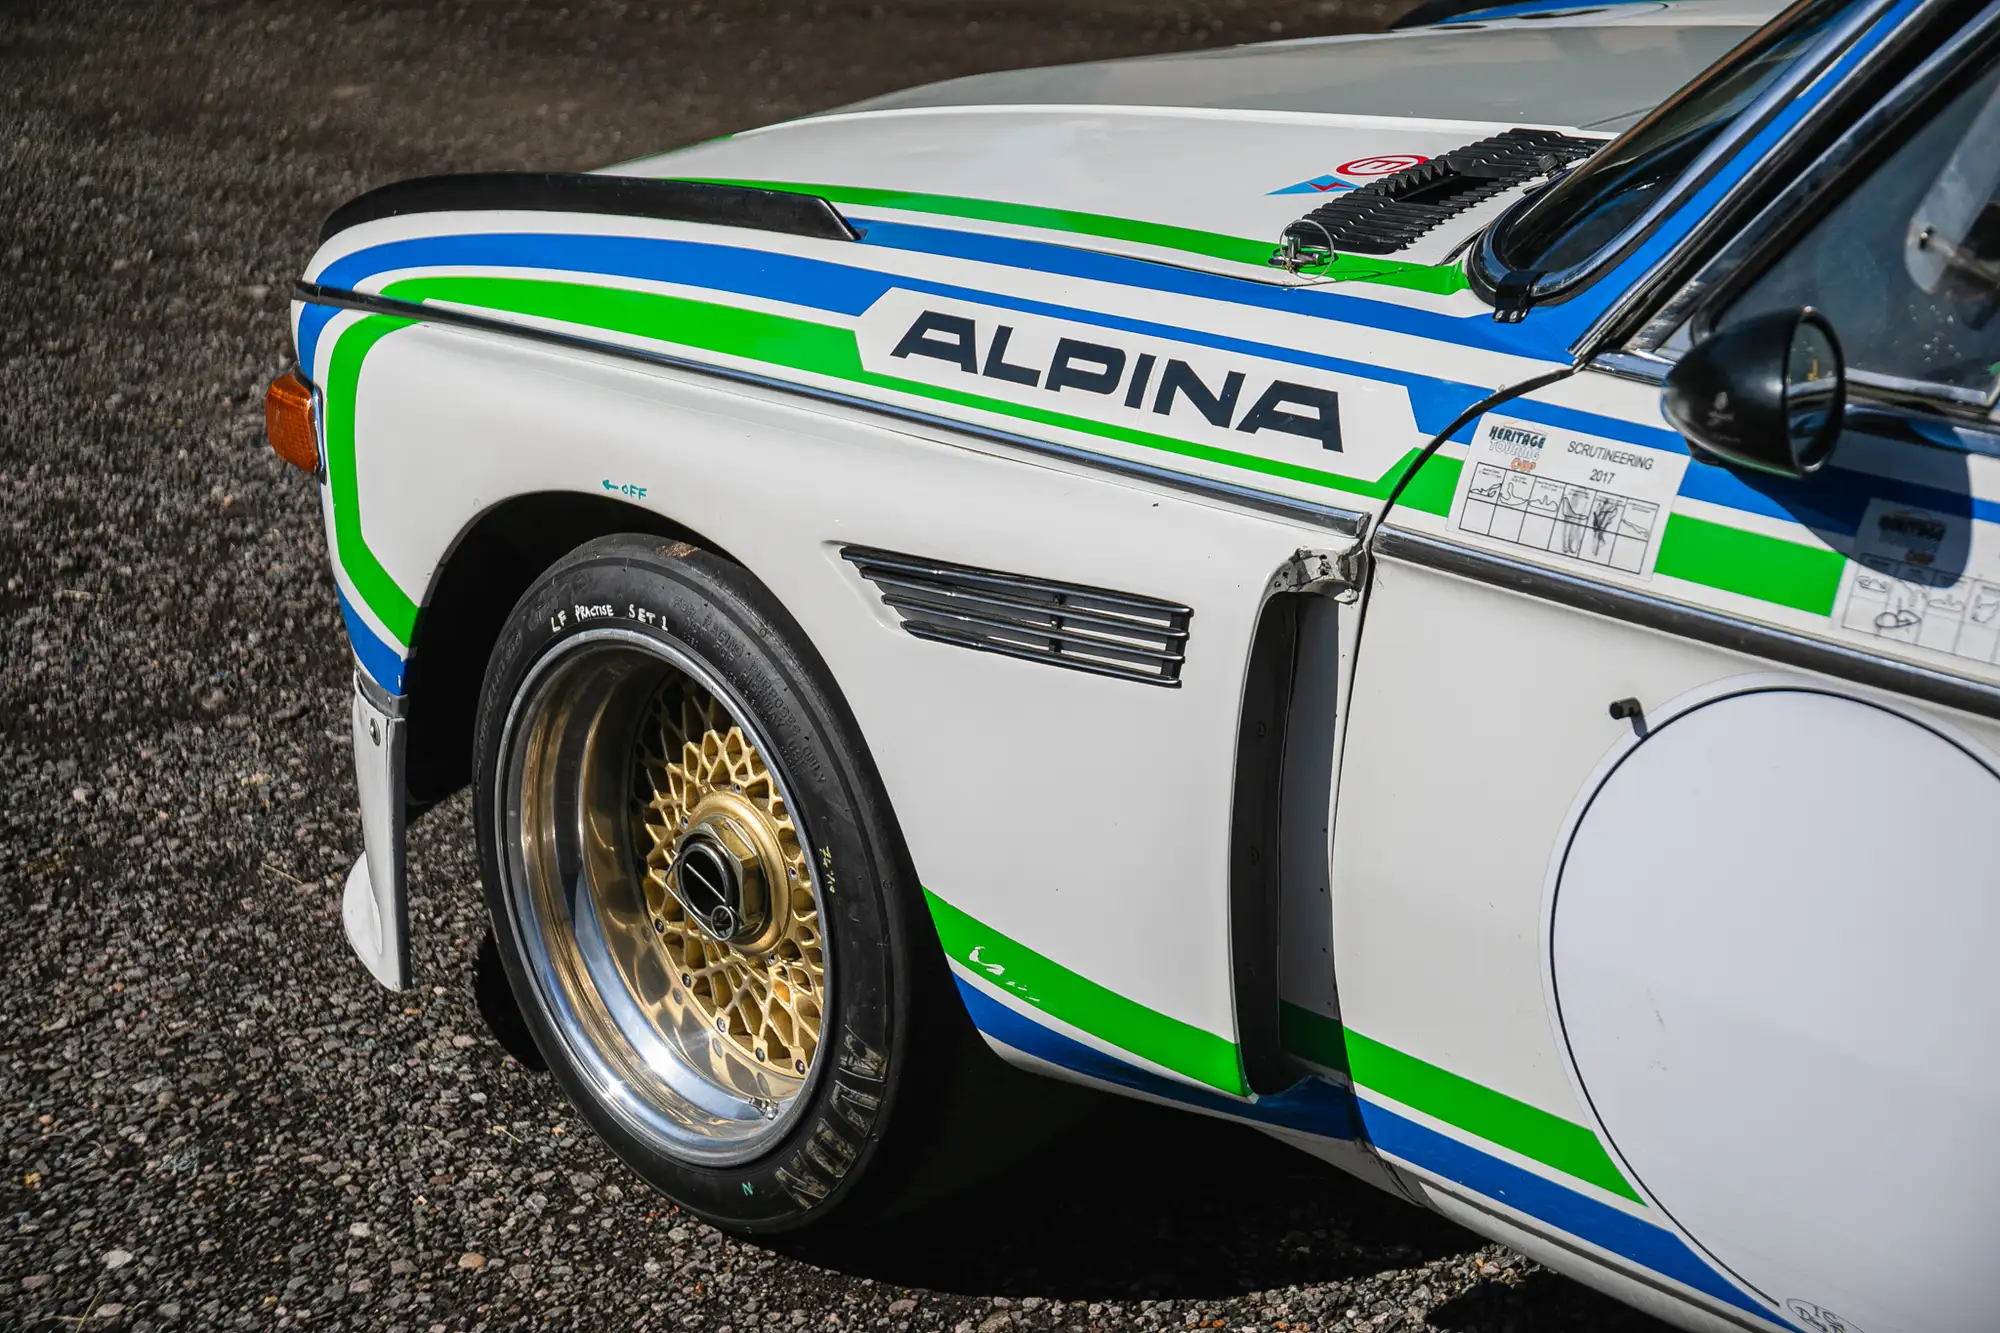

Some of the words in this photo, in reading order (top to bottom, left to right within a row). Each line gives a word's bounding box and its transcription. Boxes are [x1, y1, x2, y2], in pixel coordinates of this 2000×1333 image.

[890, 309, 1344, 454] ALPINA
[1488, 425, 1546, 449] HERITAGE
[1567, 440, 1654, 471] SCRUTINEERING
[1589, 468, 1616, 485] 2017
[621, 484, 647, 501] OFF
[550, 610, 567, 632] LF
[574, 603, 614, 622] PRACTISE
[628, 603, 656, 624] SET
[661, 615, 669, 632] 1
[774, 1023, 888, 1210] AVON
